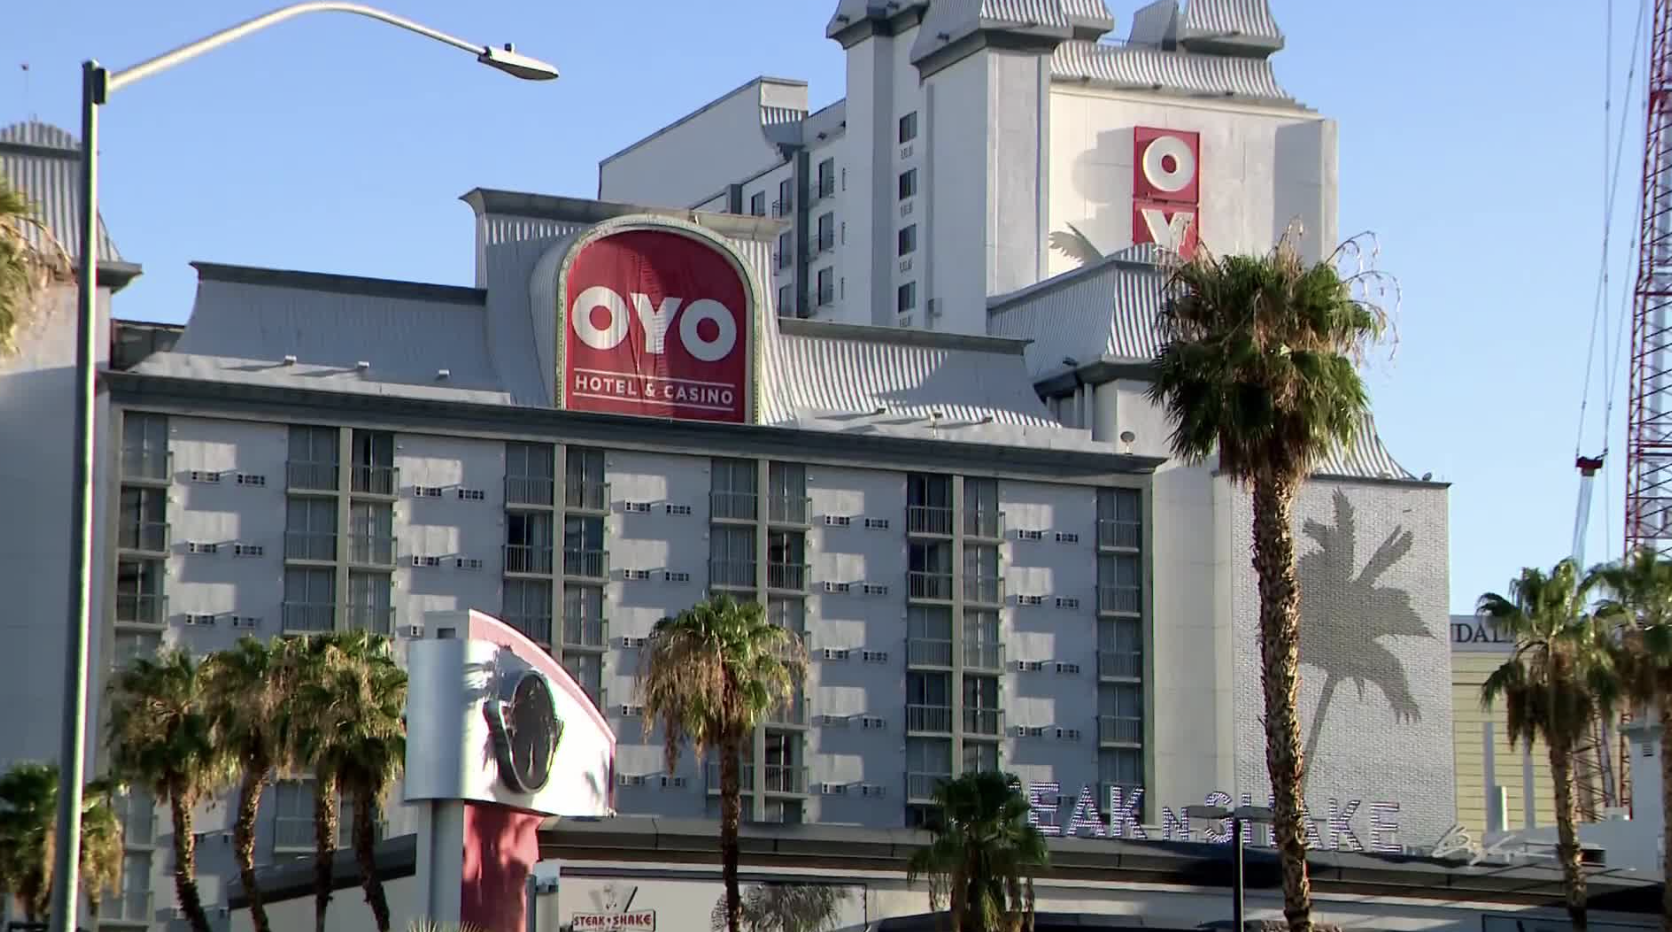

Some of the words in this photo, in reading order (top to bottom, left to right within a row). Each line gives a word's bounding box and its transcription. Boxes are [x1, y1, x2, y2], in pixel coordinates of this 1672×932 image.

[572, 286, 737, 361] OYO
[575, 375, 637, 396] HOTEL
[645, 383, 656, 398] &
[664, 385, 734, 405] CASINO
[1450, 623, 1514, 643] DAL
[1008, 782, 1147, 839] EAK
[1162, 806, 1189, 841] N
[574, 915, 605, 927] STEAK
[613, 914, 652, 926] SHAKE
